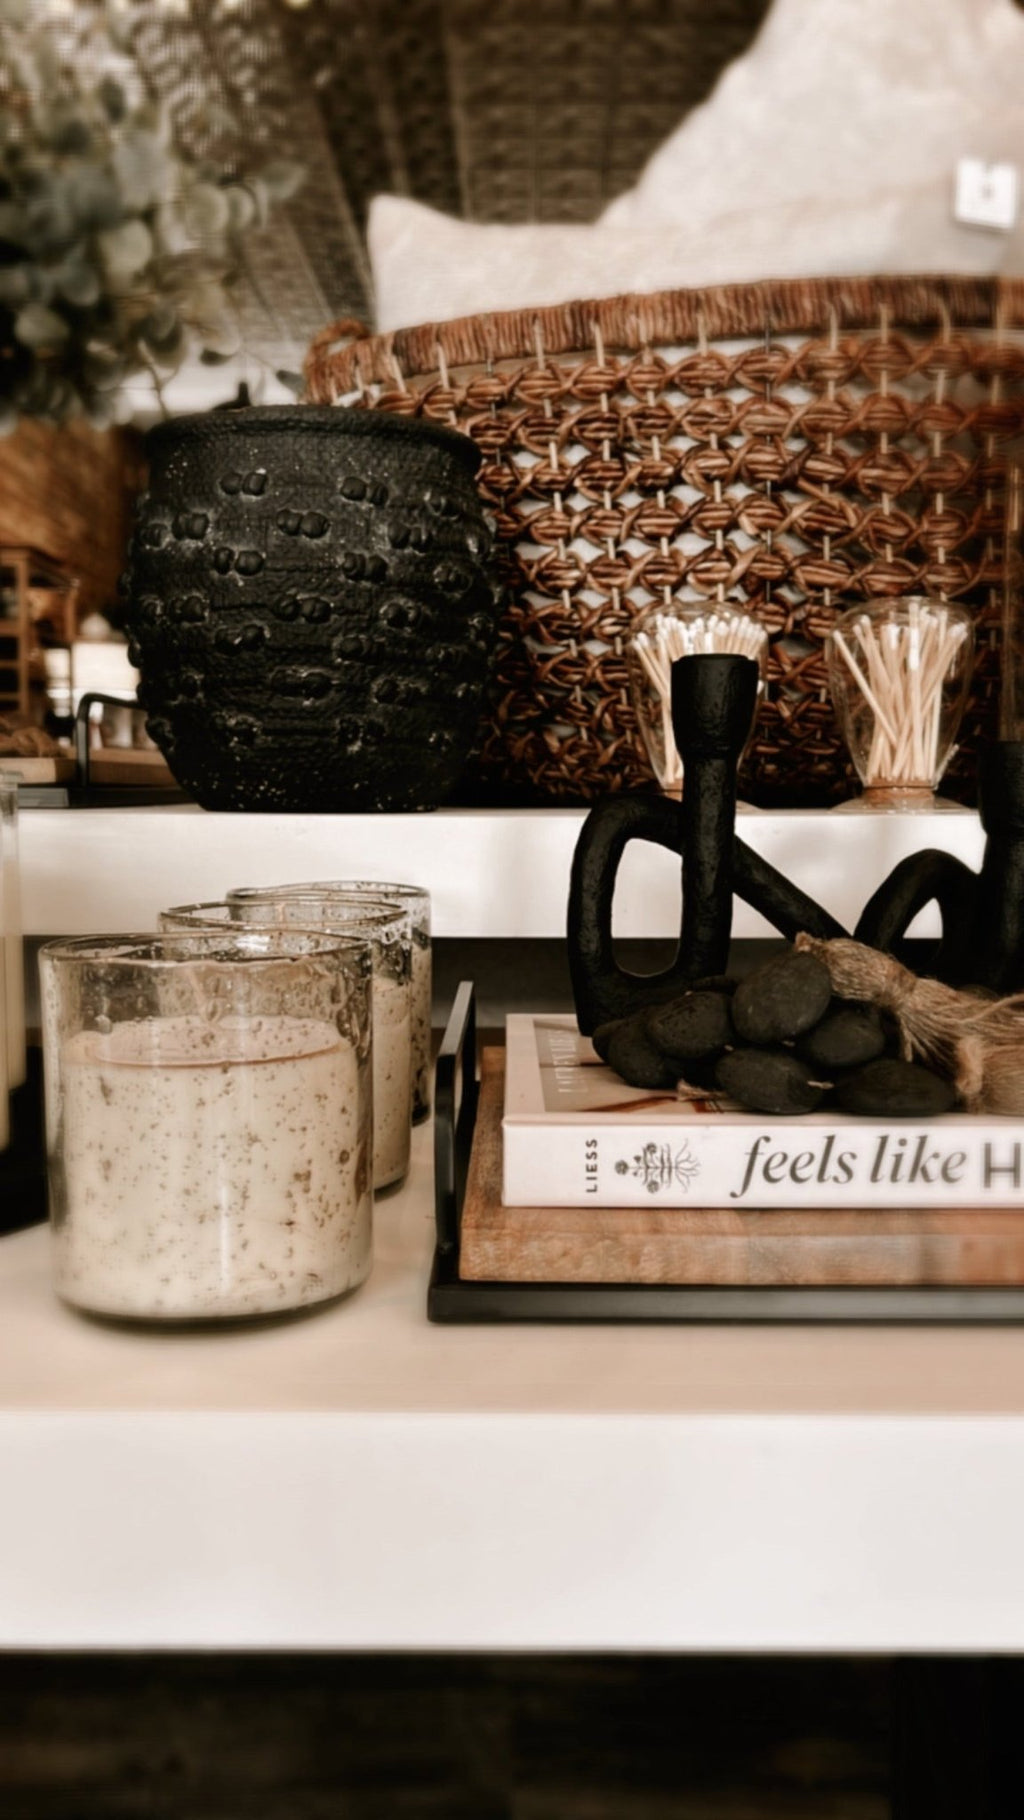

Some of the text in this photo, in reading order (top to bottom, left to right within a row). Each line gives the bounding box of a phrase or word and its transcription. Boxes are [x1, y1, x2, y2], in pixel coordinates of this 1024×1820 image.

[585, 1138, 598, 1193] LIESS
[729, 1134, 858, 1199] feels
[869, 1134, 967, 1184] like
